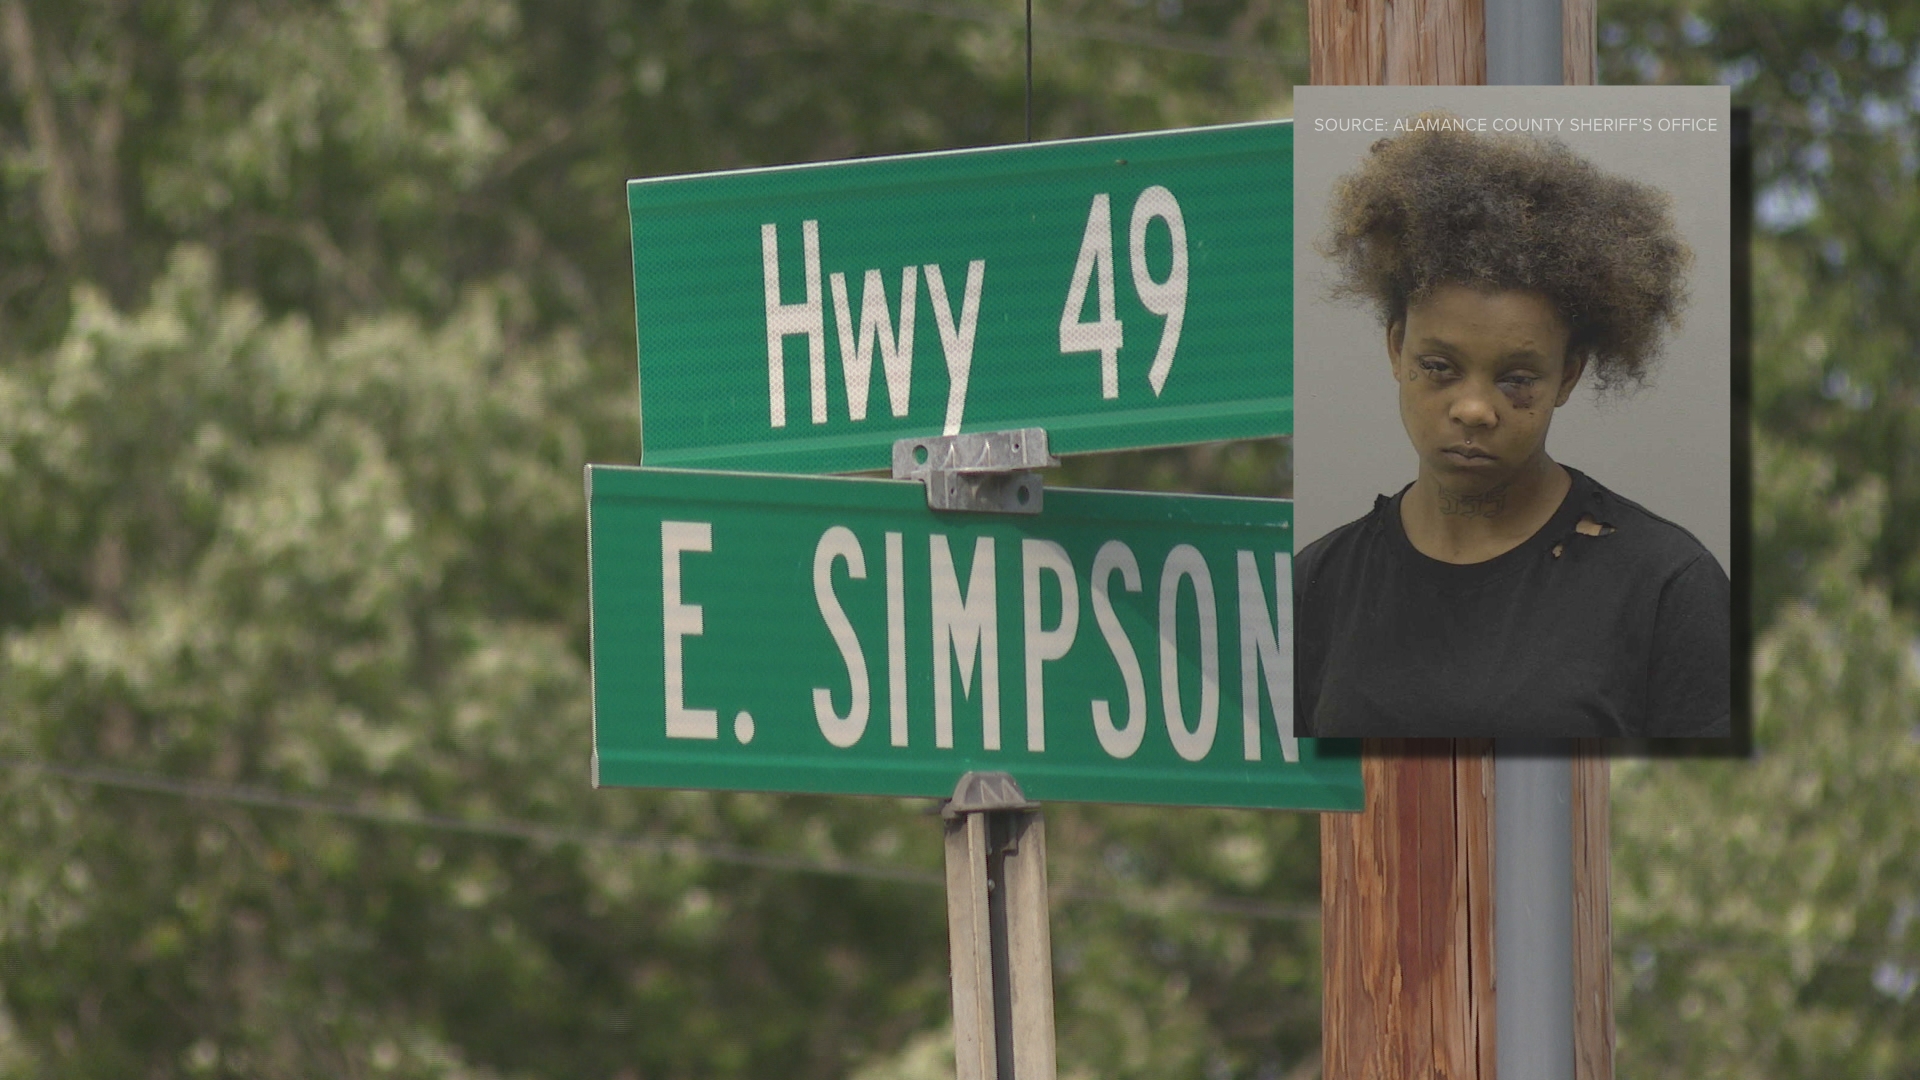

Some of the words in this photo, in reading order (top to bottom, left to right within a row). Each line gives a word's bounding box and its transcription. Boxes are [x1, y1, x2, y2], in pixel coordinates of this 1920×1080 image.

[761, 219, 986, 436] Hwy
[1060, 185, 1188, 399] 49
[661, 521, 755, 745] E.
[812, 526, 1300, 763] SIMPSON
